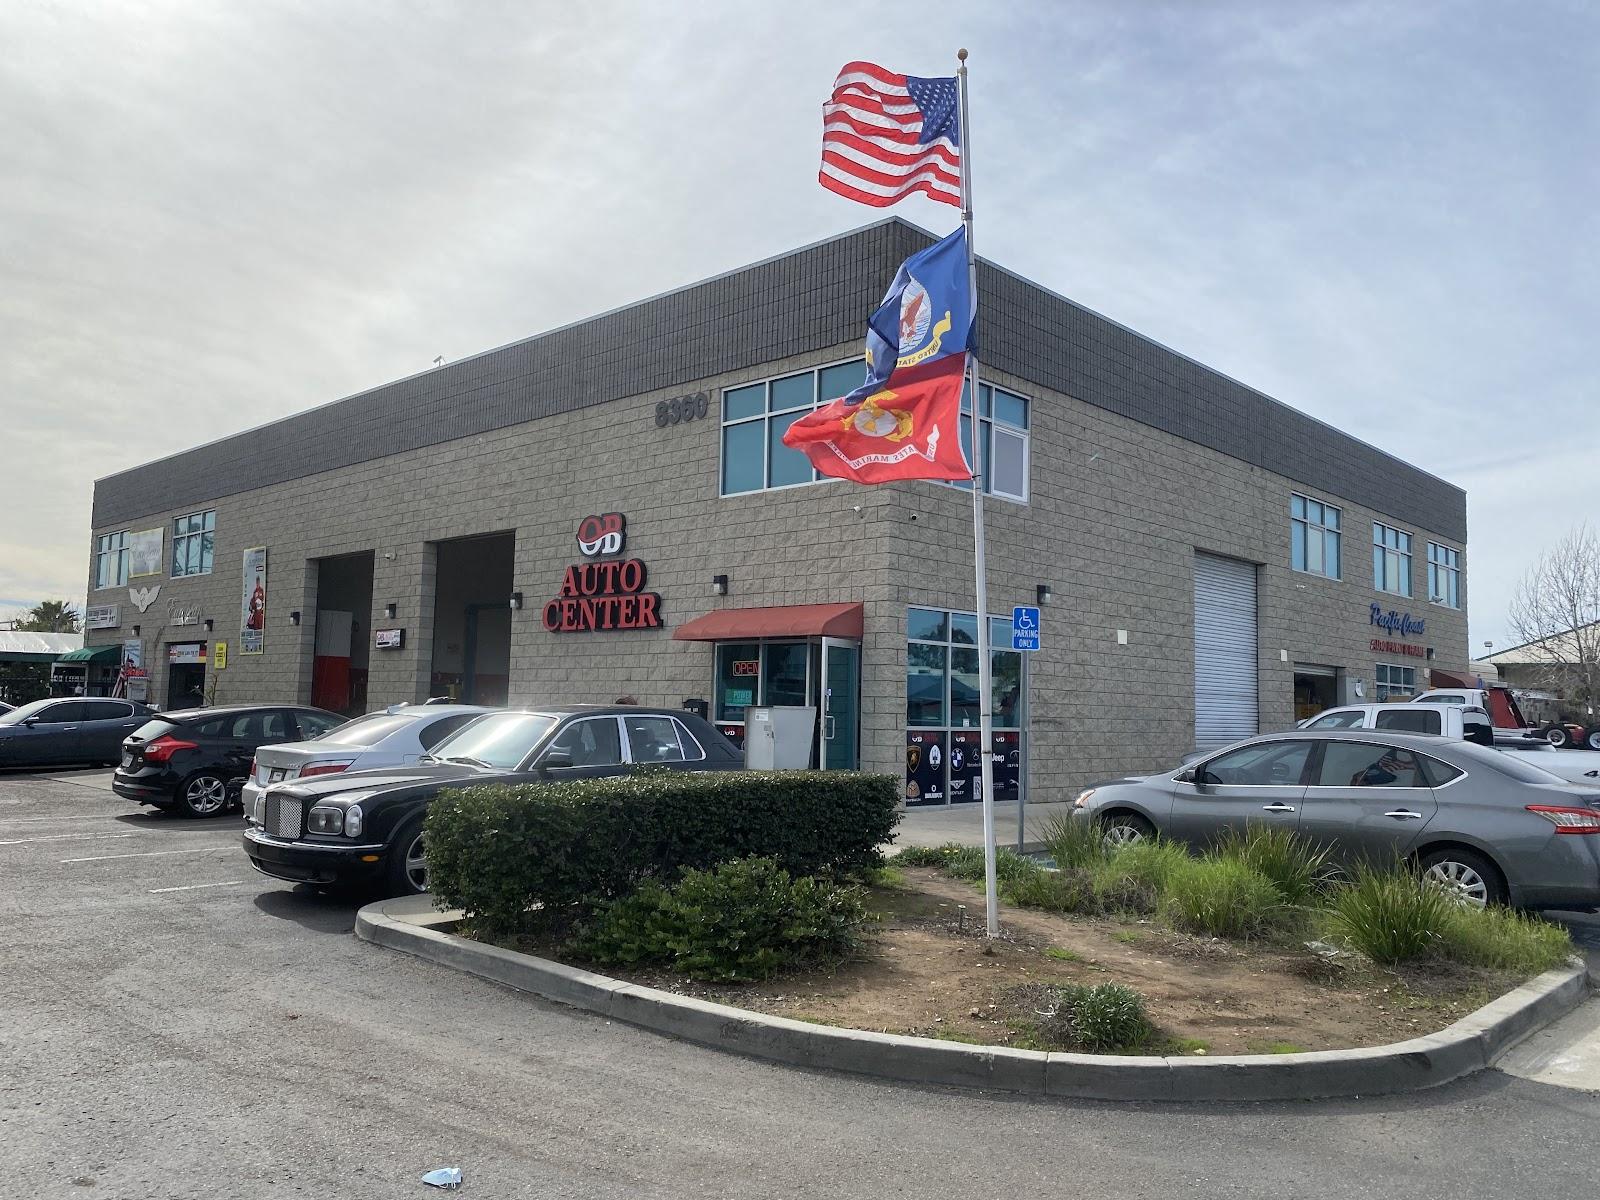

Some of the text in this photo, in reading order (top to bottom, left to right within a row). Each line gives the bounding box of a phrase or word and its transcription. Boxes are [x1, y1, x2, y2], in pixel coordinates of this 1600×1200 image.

[558, 558, 646, 597] AUTO
[542, 594, 663, 632] CENTER
[1014, 629, 1039, 639] PARKING
[1019, 638, 1034, 648] ONLY
[734, 662, 759, 674] OPEN
[992, 753, 1005, 763] Jeep
